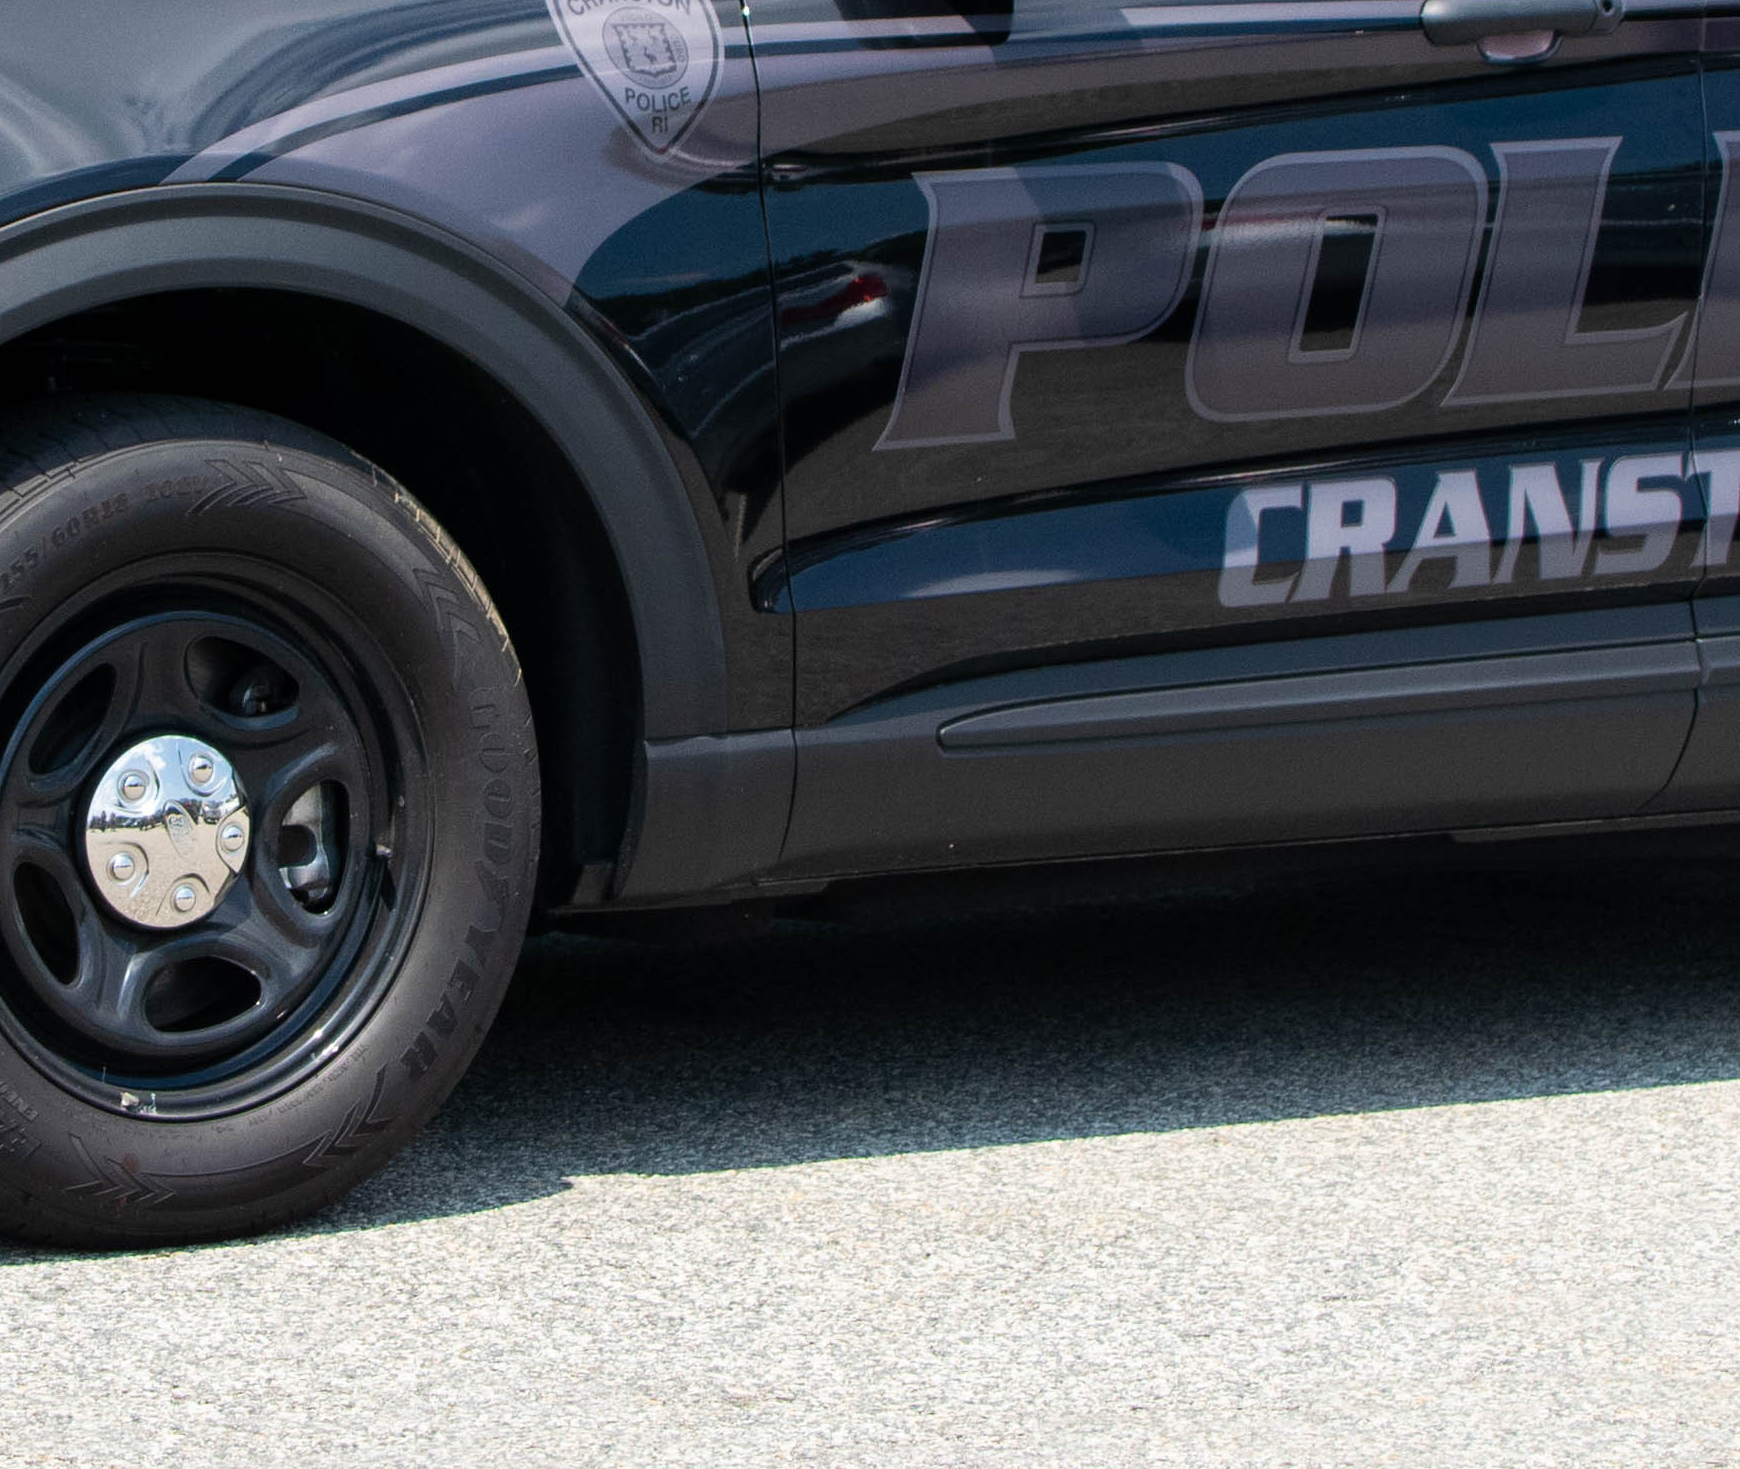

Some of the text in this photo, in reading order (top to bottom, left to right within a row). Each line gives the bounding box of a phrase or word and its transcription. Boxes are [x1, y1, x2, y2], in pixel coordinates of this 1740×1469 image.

[624, 86, 692, 113] POLICE
[652, 116, 669, 132] RI
[397, 685, 515, 1072] GOODYEAR
